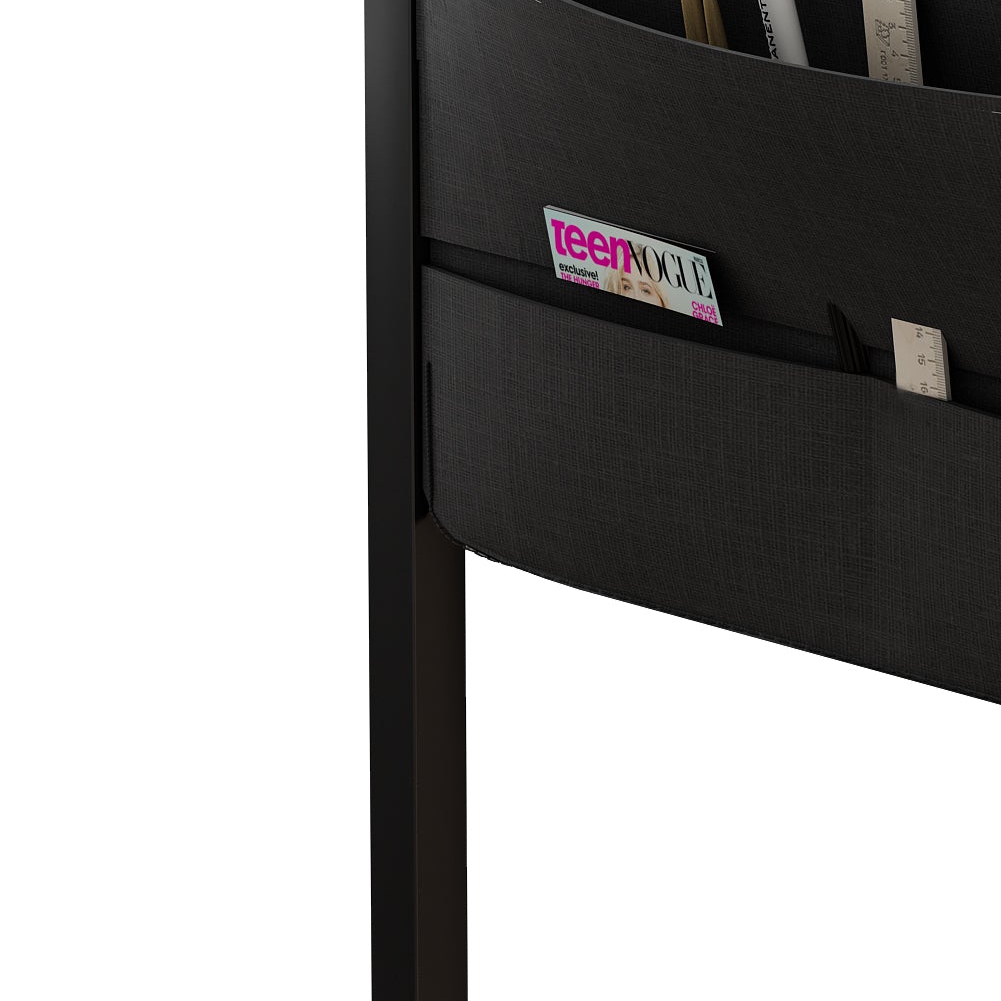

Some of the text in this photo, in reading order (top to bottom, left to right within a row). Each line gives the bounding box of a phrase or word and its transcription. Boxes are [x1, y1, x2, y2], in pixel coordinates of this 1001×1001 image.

[891, 49, 899, 57] 4
[559, 262, 599, 281] exclusive!
[915, 326, 924, 339] 14
[917, 353, 926, 366] 15
[920, 381, 928, 394] 16
